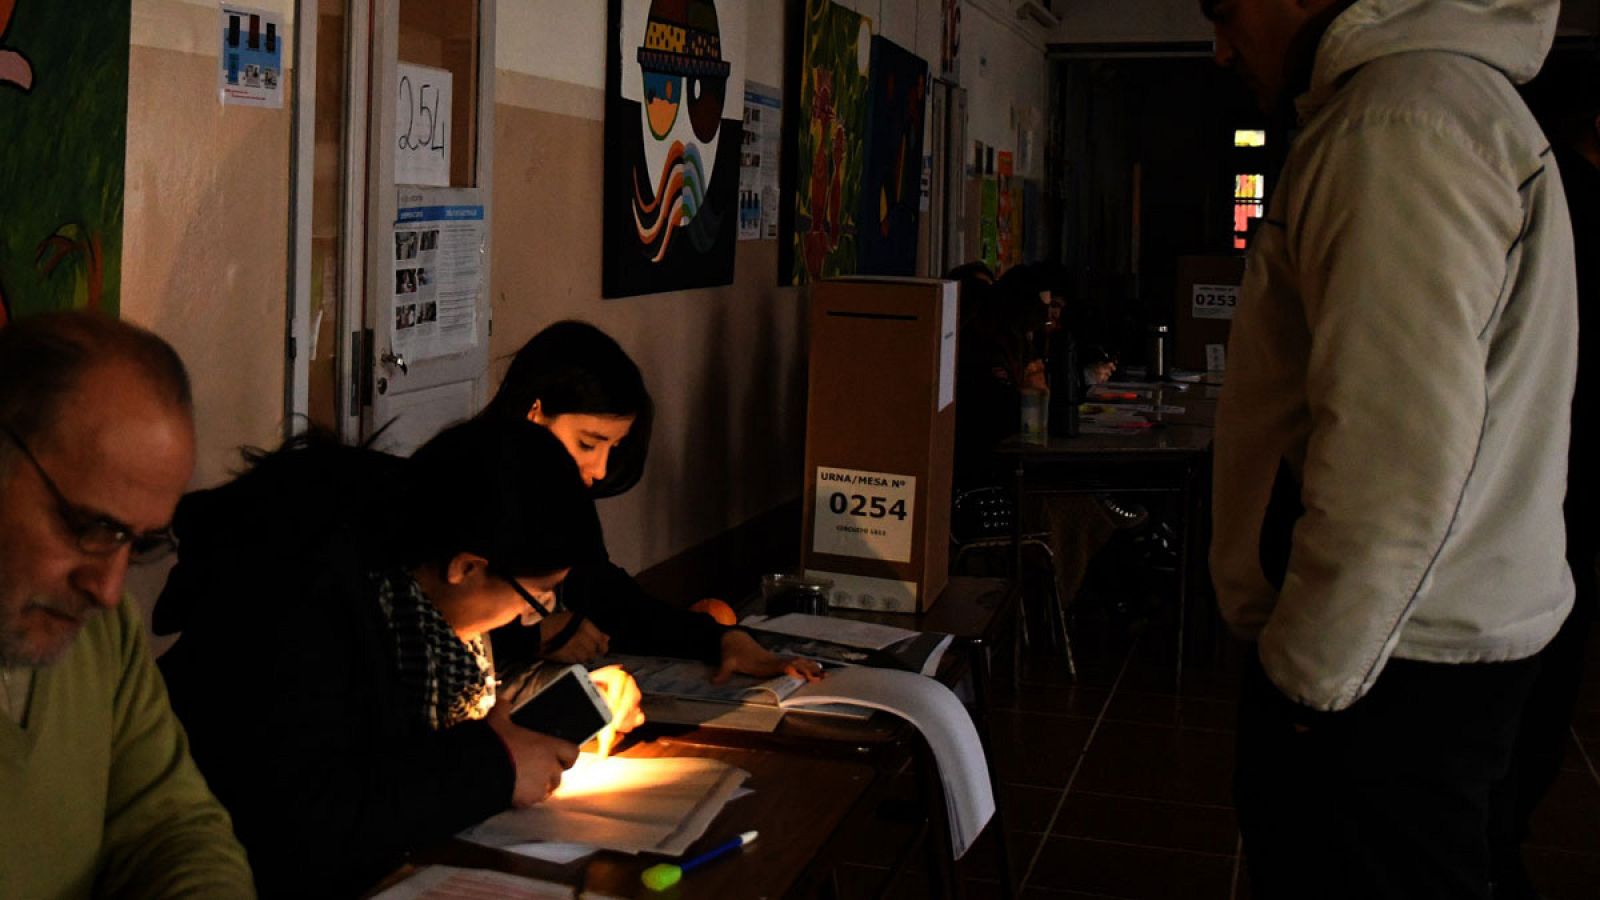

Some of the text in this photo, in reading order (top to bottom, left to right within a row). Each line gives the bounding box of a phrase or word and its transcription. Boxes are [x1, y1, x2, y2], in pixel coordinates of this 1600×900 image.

[399, 75, 445, 159] 254
[1195, 294, 1236, 306] 0253
[820, 472, 888, 486] URNA/MESA
[830, 492, 907, 520] 0254
